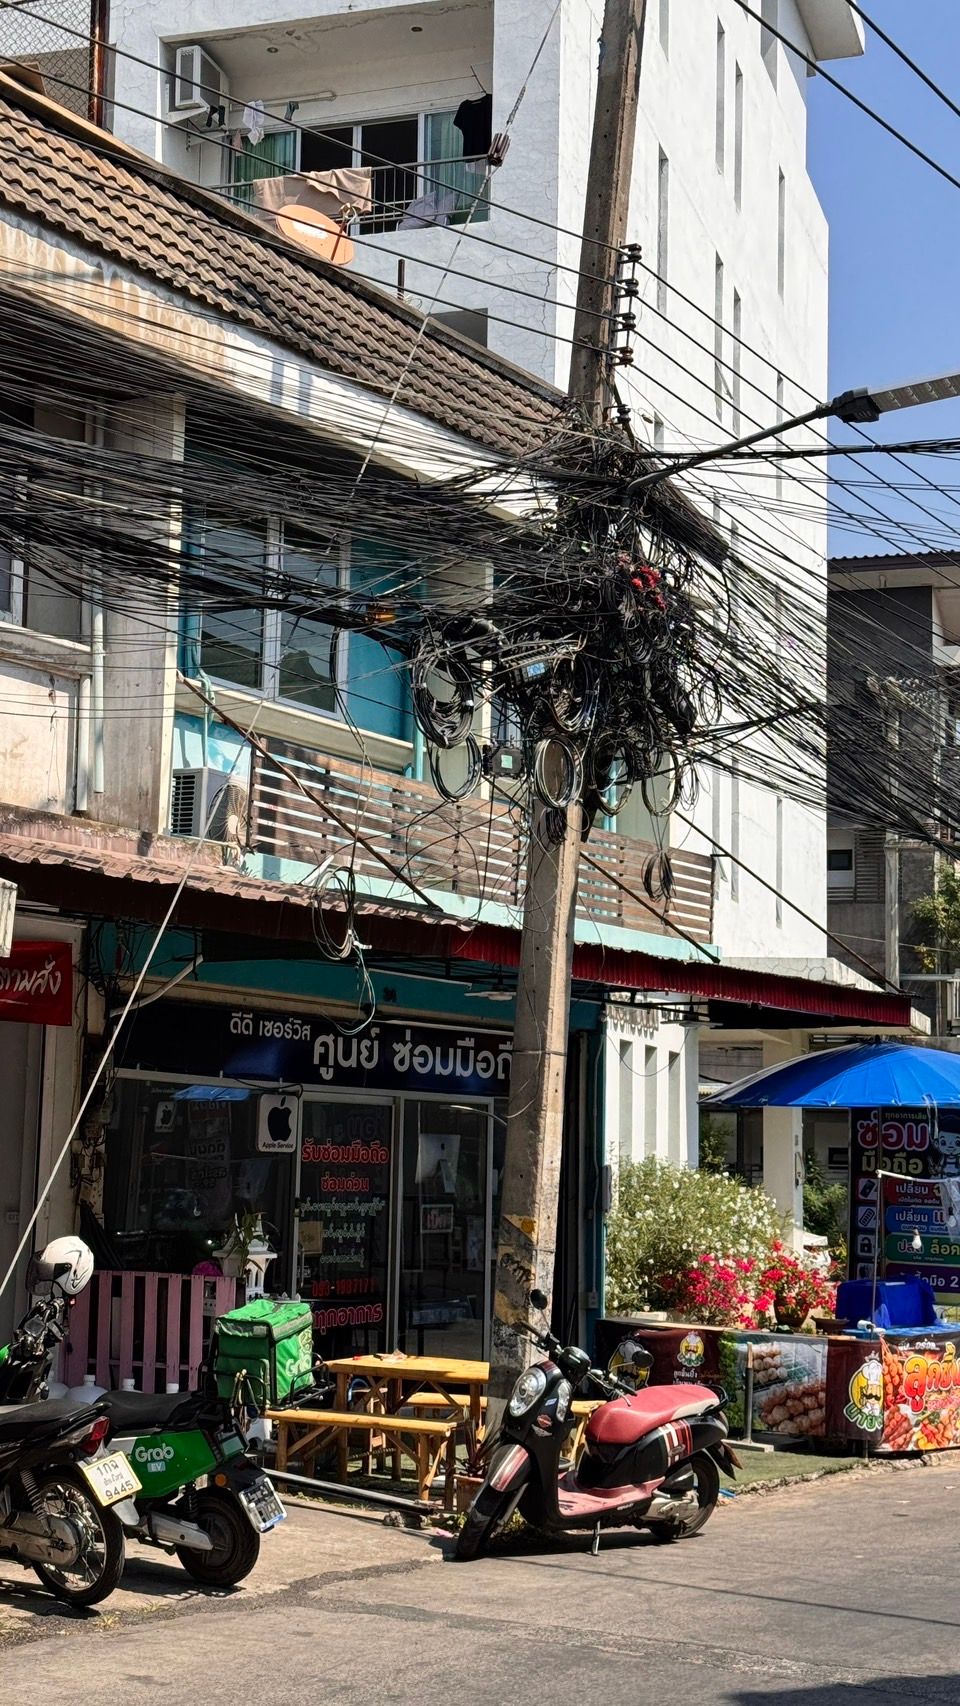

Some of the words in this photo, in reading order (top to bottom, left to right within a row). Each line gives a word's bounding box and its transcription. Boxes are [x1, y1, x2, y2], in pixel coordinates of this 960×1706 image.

[230, 1012, 253, 1036] ดีดี
[259, 1017, 311, 1041] เซอร์วิส
[313, 1027, 380, 1081] ศูนย์
[392, 1029, 514, 1080] ซ่อมมือถื
[857, 1110, 930, 1152] ซ่อม
[261, 1141, 277, 1149] Apple
[277, 1142, 294, 1150] Service
[302, 1137, 389, 1164] รับซ่อมมือถือ
[950, 1275, 960, 1288] 2
[134, 1443, 175, 1463] Grab
[105, 1480, 134, 1500] 9445
